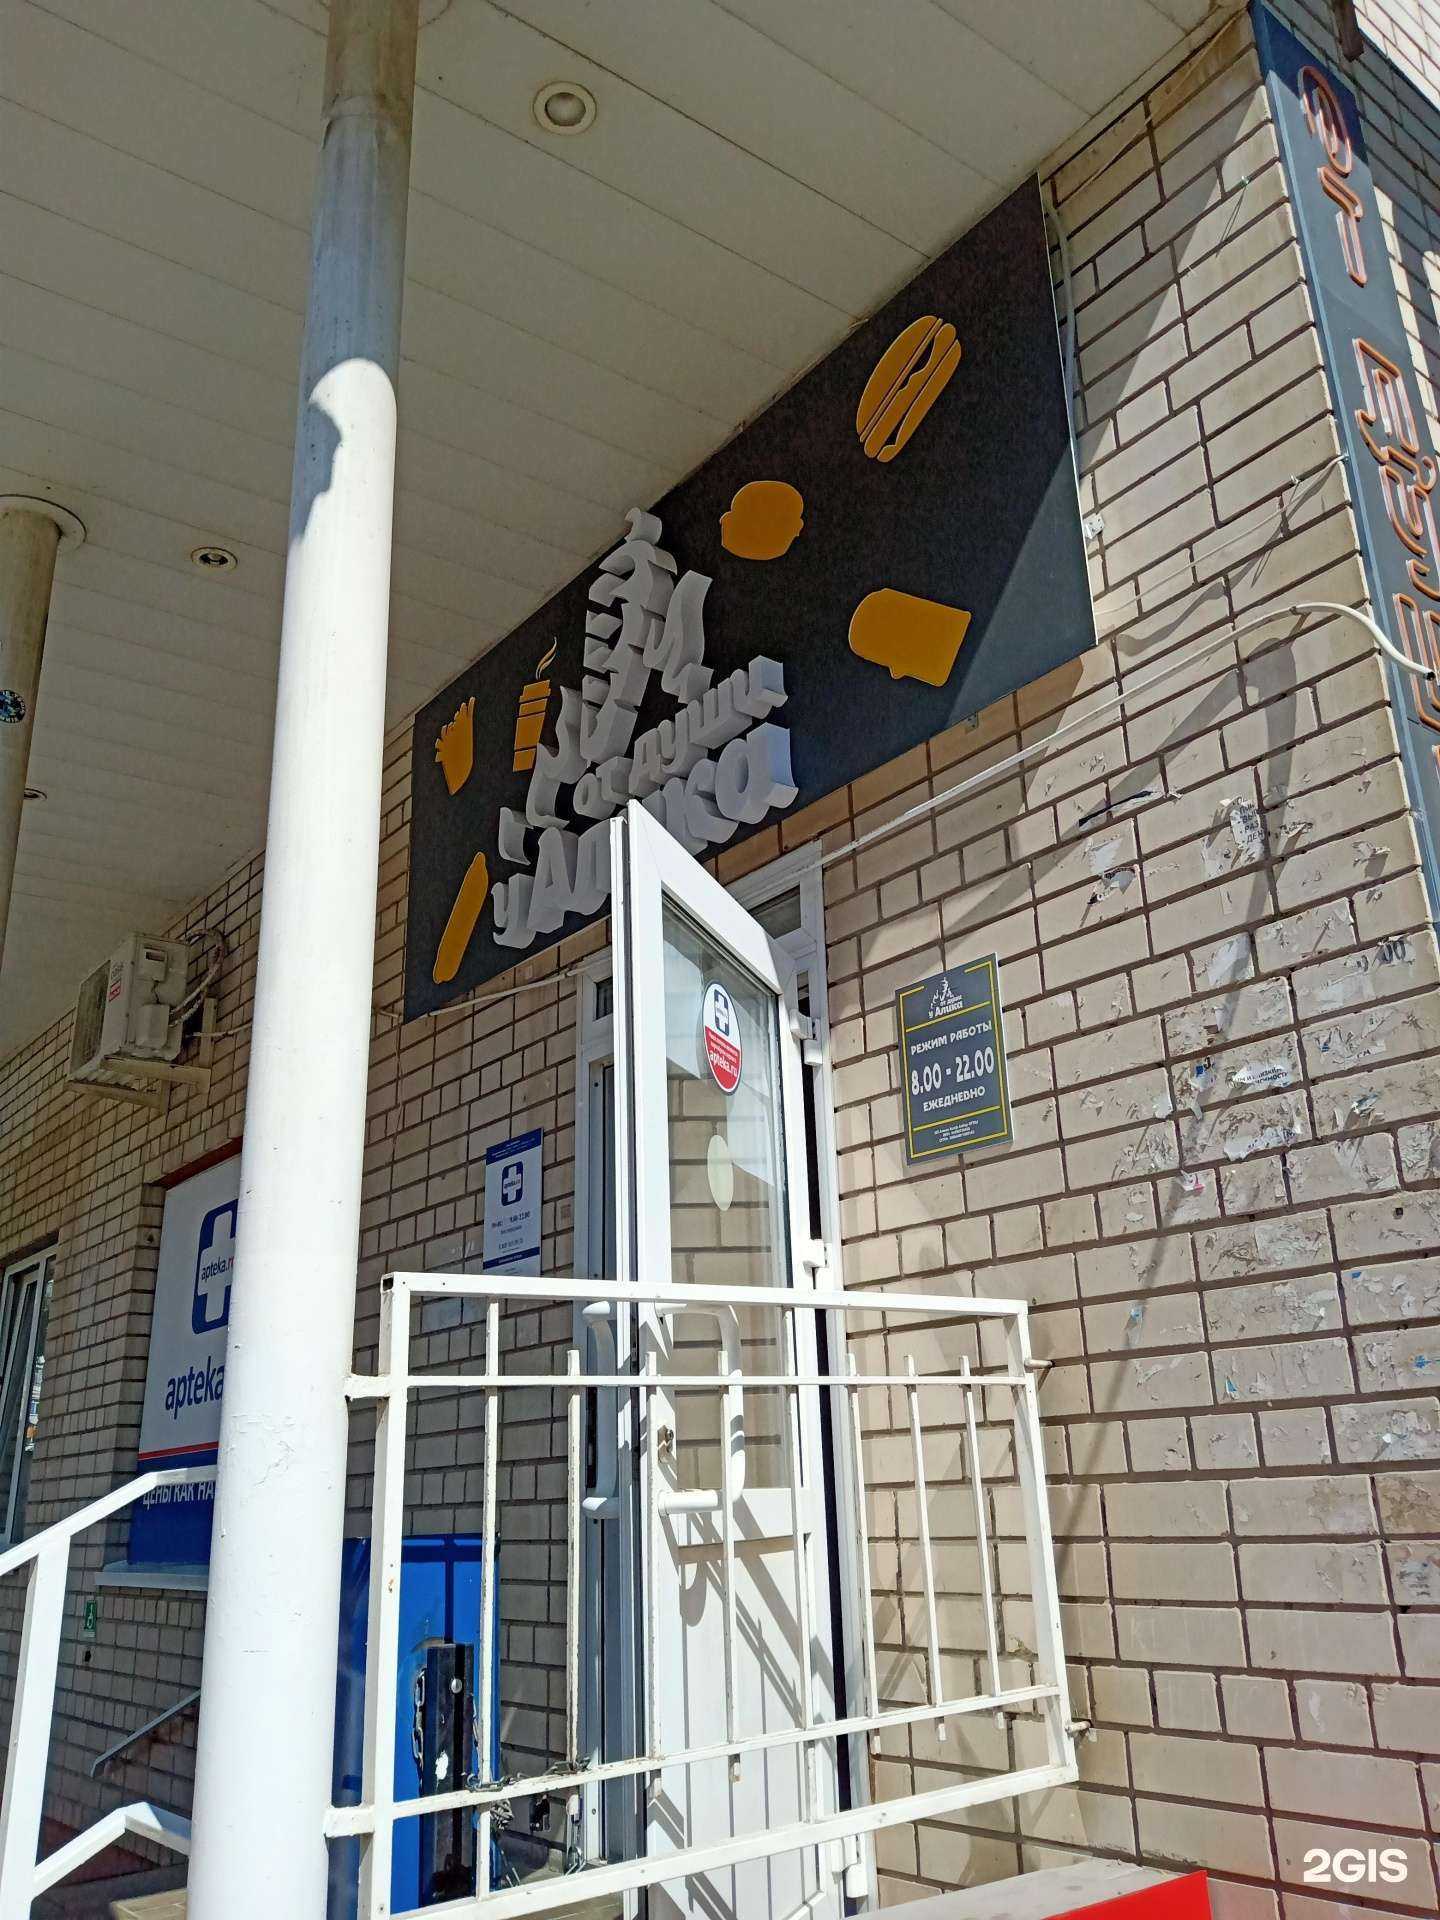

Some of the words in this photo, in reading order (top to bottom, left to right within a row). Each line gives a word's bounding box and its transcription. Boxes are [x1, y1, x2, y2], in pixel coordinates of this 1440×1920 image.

[910, 1034, 948, 1056] РЕЖИМ
[950, 1019, 993, 1045] РАБОТЫ
[922, 1085, 987, 1113] ЕЖЕДНЕВНО
[173, 1483, 194, 1503] КАК
